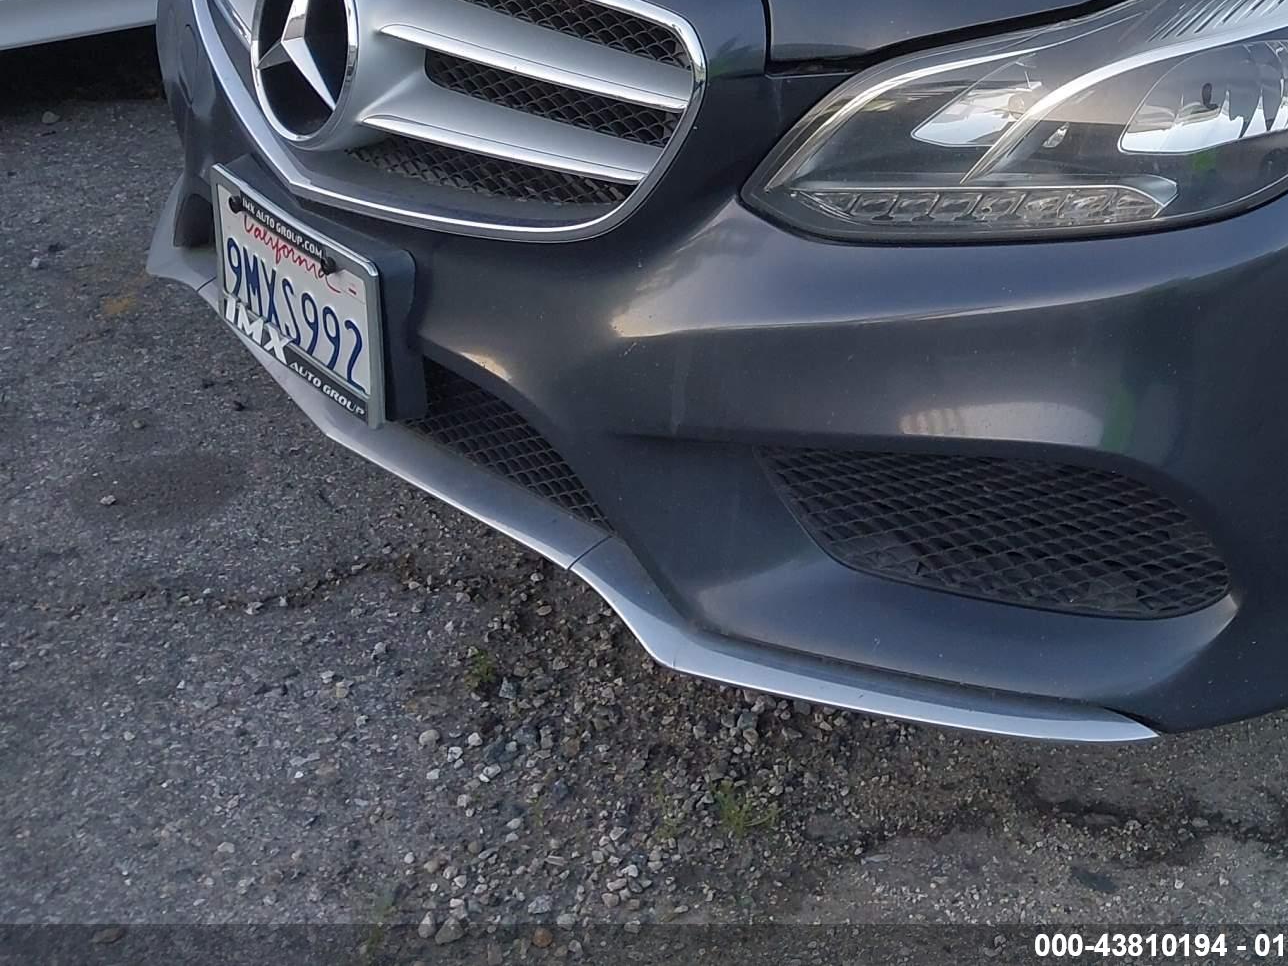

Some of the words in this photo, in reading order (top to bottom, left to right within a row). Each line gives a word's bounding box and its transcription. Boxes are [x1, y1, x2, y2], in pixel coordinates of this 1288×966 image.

[256, 209, 275, 229] AUTO
[275, 222, 324, 260] GROUP.COM
[225, 294, 294, 365] IMX
[289, 361, 323, 389] AUTO
[322, 384, 366, 417] GROUP
[226, 236, 367, 394] 9MXS992
